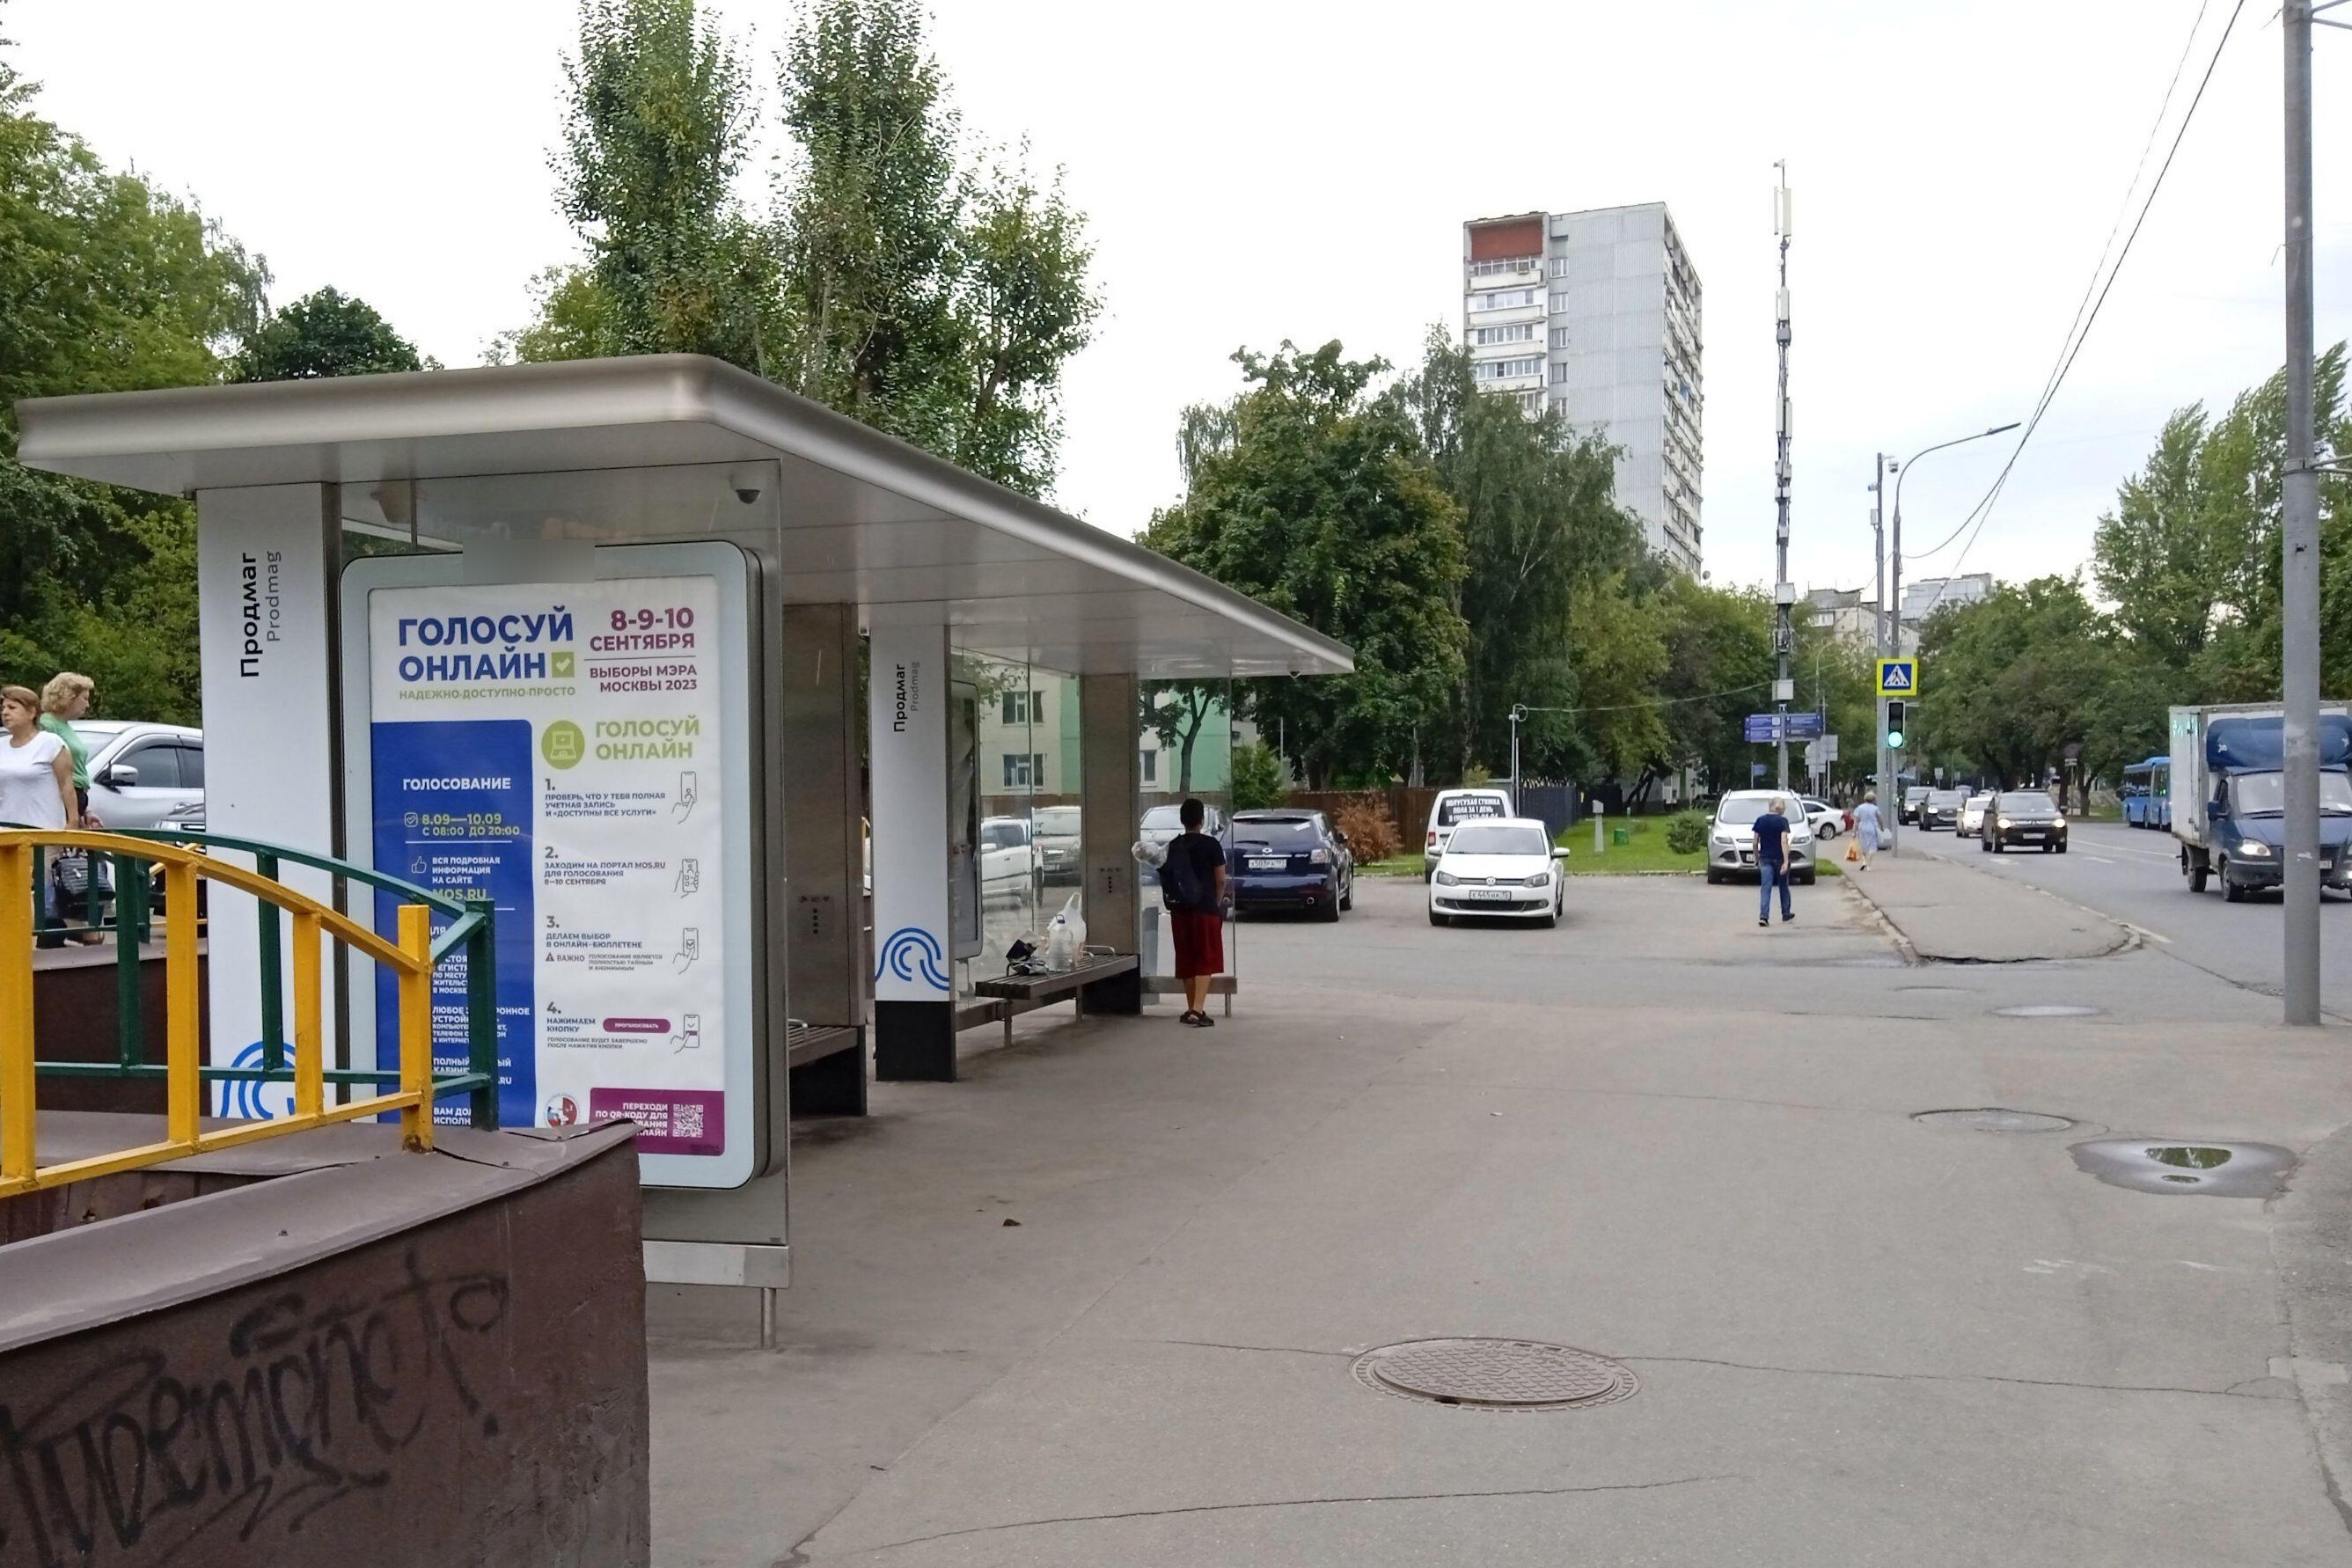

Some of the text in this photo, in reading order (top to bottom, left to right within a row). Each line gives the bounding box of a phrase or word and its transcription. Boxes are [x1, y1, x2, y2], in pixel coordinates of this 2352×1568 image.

[265, 551, 282, 641] Prodmag
[240, 553, 262, 678] Продмаг
[611, 607, 694, 631] 8-9-10
[399, 605, 573, 646] ГОЛОСУЙ
[590, 633, 695, 652] СЕНТЯБРЯ
[399, 646, 546, 682] ОНЛАЙН
[590, 664, 697, 678] ВЫБОРЫ МЭРА
[600, 679, 697, 692] МОСКВЫ 2023
[894, 664, 908, 732] Продмаг
[596, 714, 700, 737] ГОЛОСУЙ
[596, 738, 692, 760] ОНЛАЙН
[403, 778, 511, 790] ГОЛОСОВАНИЕ
[545, 779, 555, 791] 1.
[422, 826, 520, 837] С 08:00 ДО 20:00
[545, 846, 559, 859] 2.
[451, 856, 501, 865] ПОДРОБНАЯ
[445, 876, 473, 884] САЙТЕ
[546, 915, 560, 928] 3.
[430, 927, 446, 935] ЛЯ
[432, 1006, 464, 1015] ЛЮБОЕ
[546, 1001, 561, 1014] 4.
[433, 1057, 470, 1066] ПОЛНЫЙ
[623, 1103, 668, 1111] ПЕРЕХОДИ
